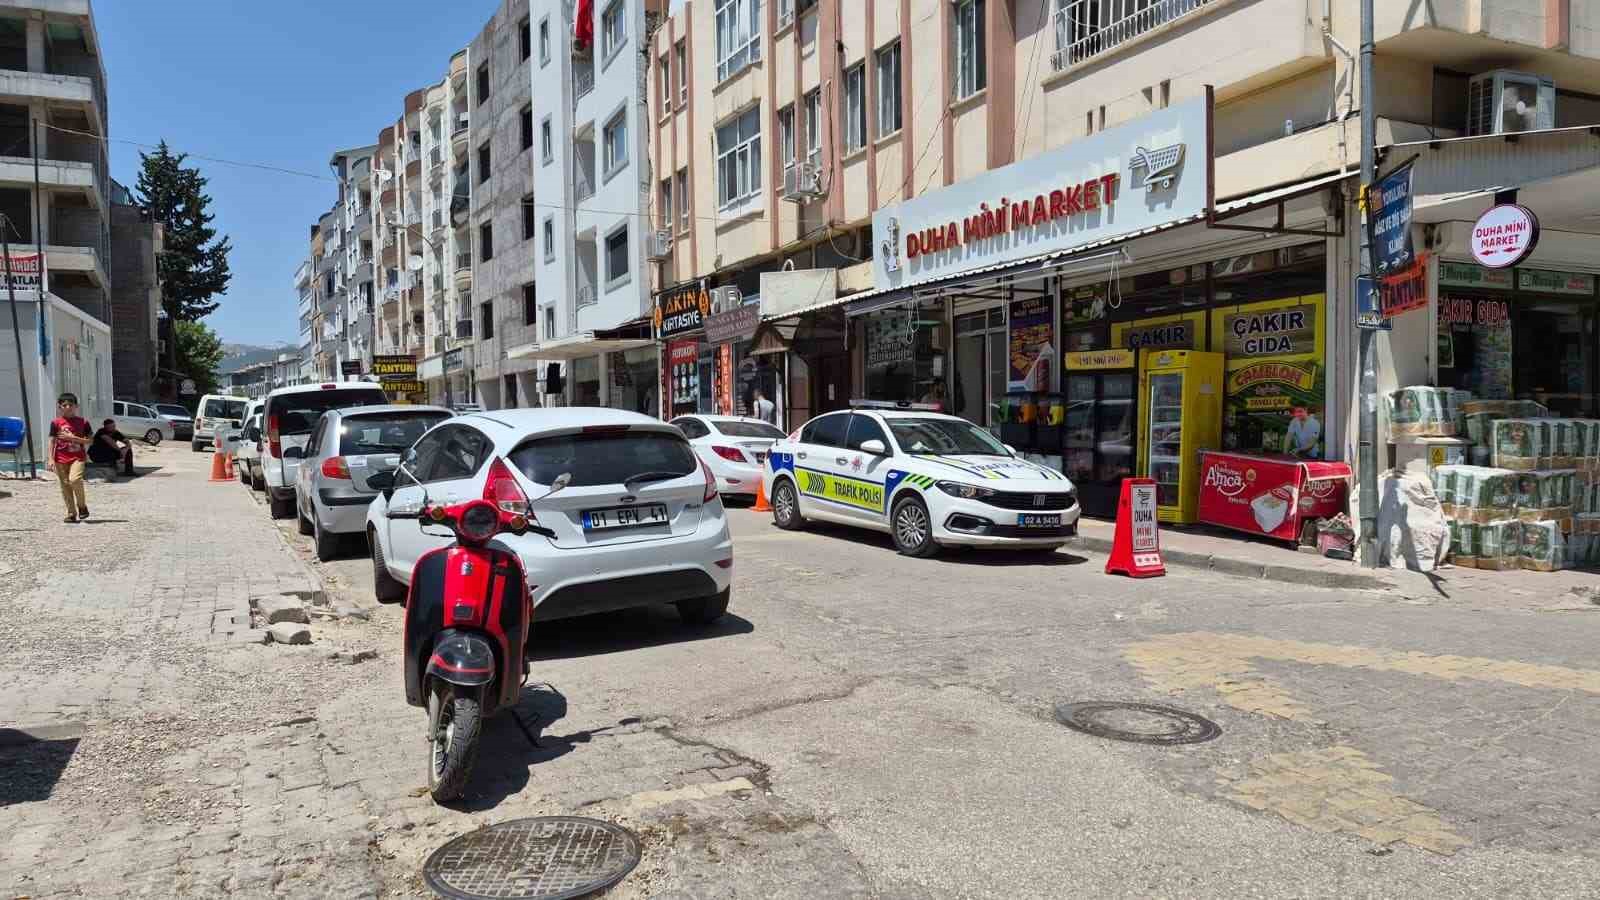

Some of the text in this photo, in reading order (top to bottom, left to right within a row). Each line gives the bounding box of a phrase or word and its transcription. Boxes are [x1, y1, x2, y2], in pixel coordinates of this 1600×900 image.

[906, 172, 1118, 259] DUHA MİNİ MARKET
[1476, 219, 1527, 238] DUHA MİNİ
[1481, 234, 1520, 248] MARKET
[665, 289, 696, 313] AKIN
[1477, 299, 1509, 324] GIDA
[662, 310, 700, 332] KIRTASİYE
[1233, 311, 1305, 339] ÇAKIR
[1129, 326, 1186, 351] ÇAKIR
[1244, 338, 1292, 355] GIDA
[1204, 467, 1242, 487] Amca
[592, 512, 607, 527] 01
[651, 507, 665, 521] 41
[1135, 509, 1153, 523] DUHA
